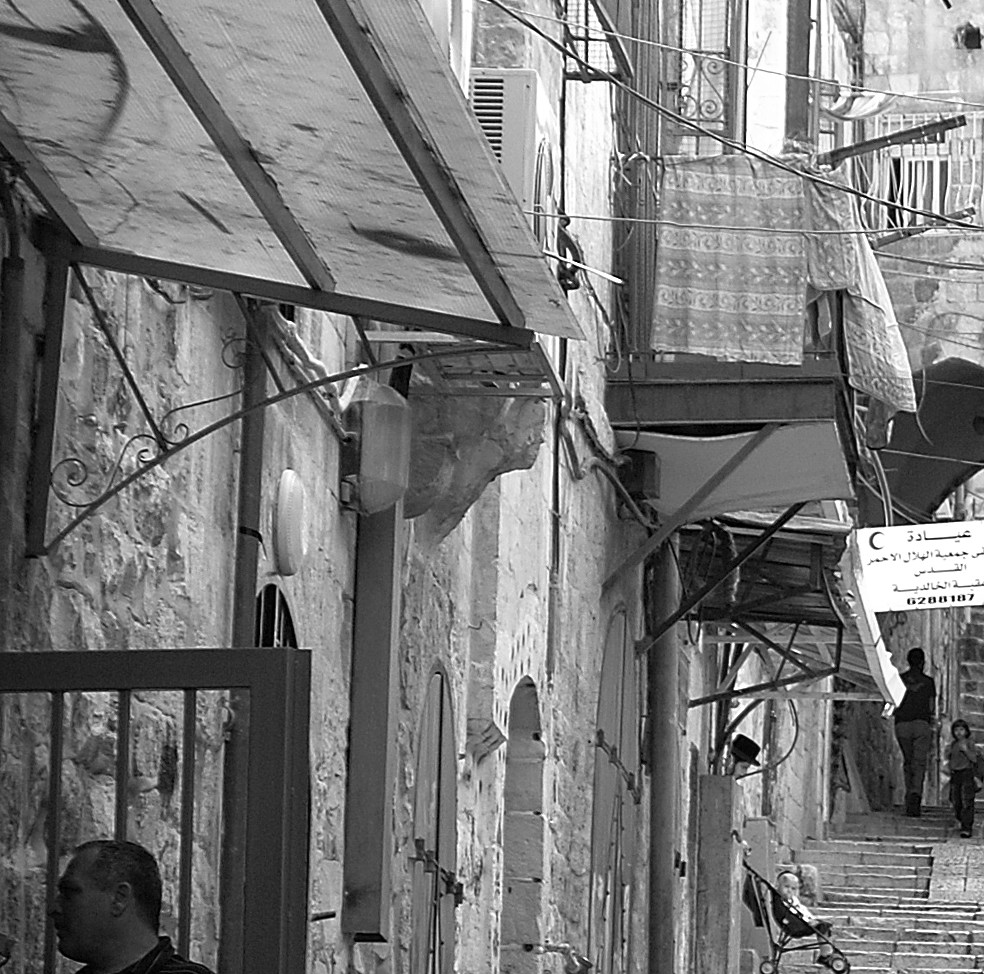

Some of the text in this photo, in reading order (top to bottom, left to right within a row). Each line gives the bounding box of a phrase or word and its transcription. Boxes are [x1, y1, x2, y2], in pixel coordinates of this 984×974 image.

[907, 530, 972, 543] عيادة
[903, 550, 934, 563] الهلال
[935, 548, 969, 561] جمعية
[914, 563, 967, 577] القدس
[892, 581, 951, 595] الخالدية
[906, 593, 975, 606] 6288187
